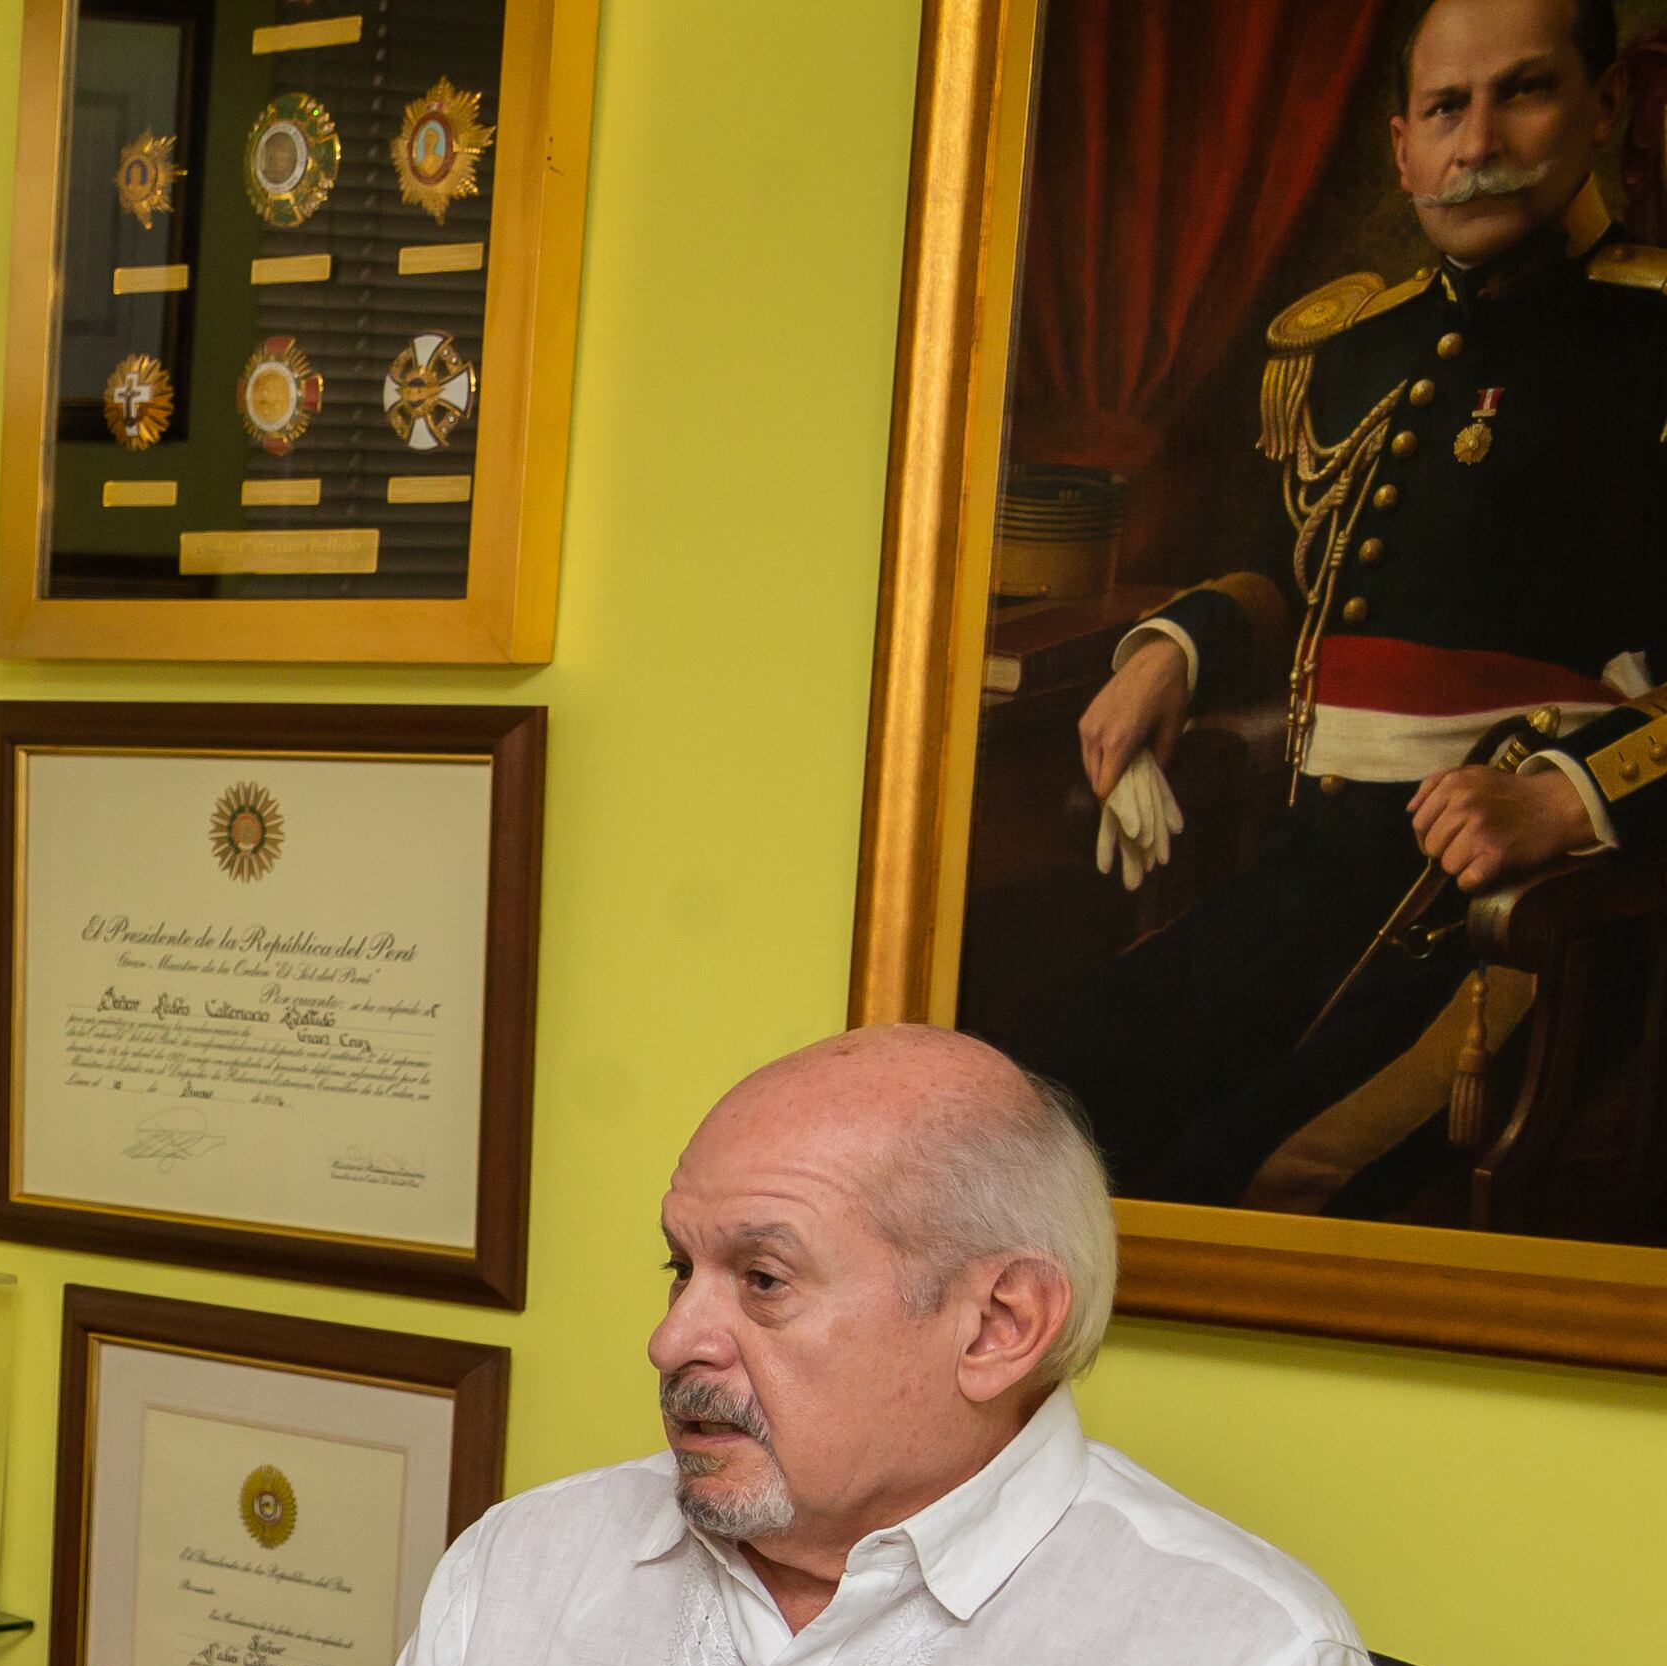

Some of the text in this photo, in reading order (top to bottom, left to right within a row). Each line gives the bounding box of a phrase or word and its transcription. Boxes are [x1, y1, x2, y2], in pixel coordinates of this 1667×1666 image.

[81, 914, 418, 962] El Presidente de la República del Perú
